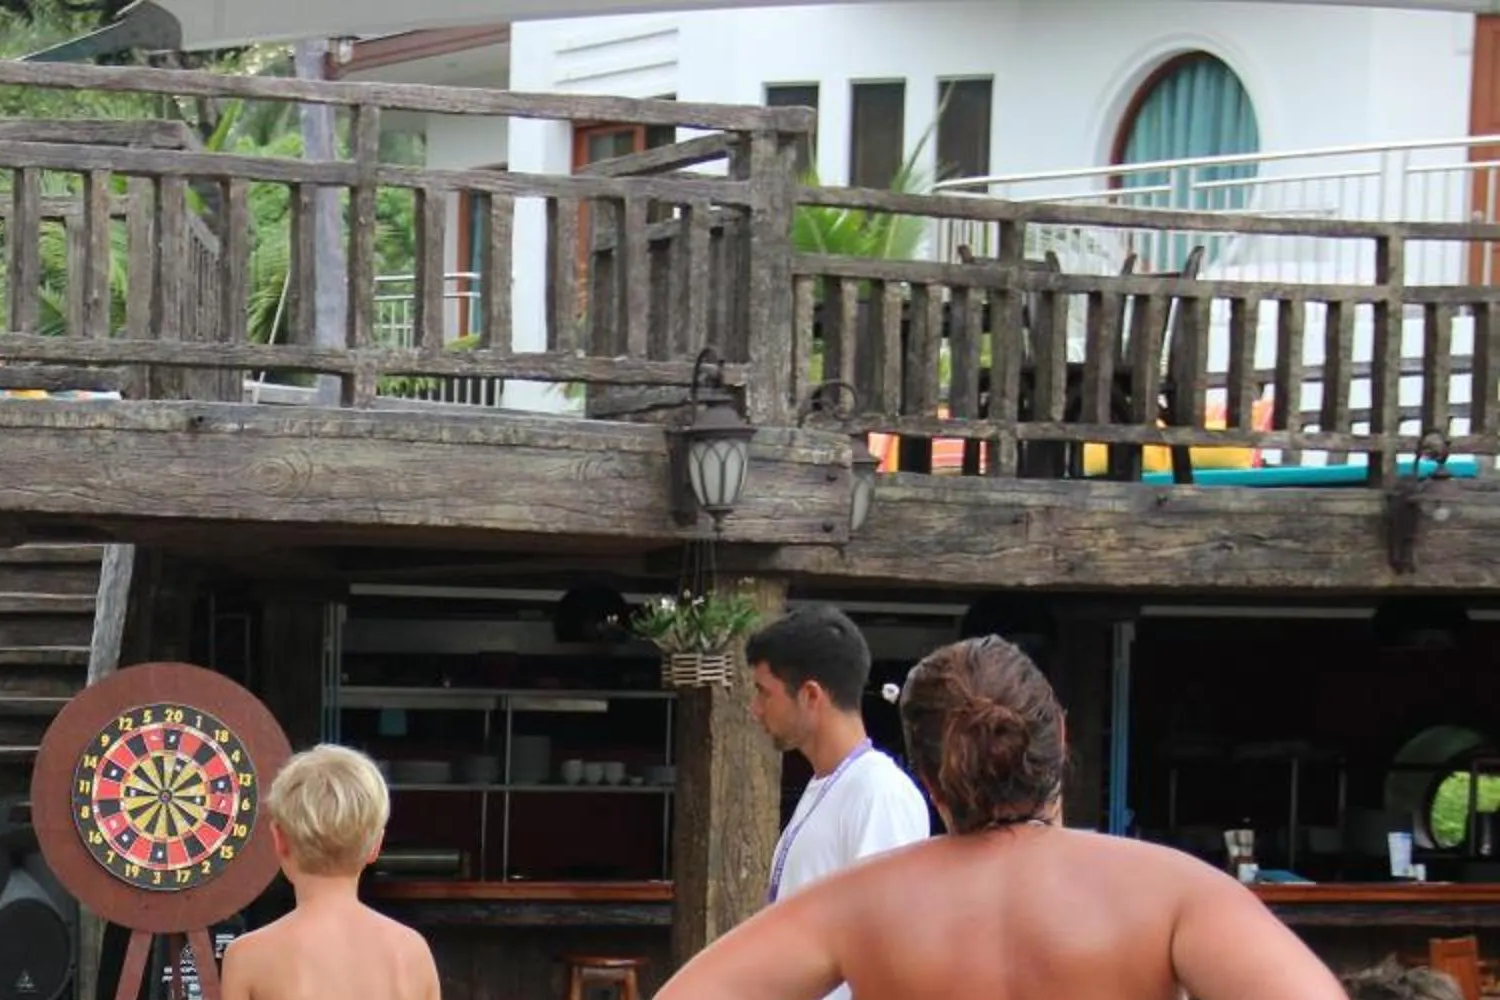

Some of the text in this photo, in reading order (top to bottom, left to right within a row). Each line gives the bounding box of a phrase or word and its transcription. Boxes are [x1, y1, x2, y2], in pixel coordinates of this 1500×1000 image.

[142, 709, 152, 723] 5
[164, 708, 184, 723] 20
[195, 714, 203, 727] 1
[119, 717, 133, 731] 12
[100, 734, 111, 747] 9
[214, 729, 229, 743] 18
[83, 754, 98, 769] 14
[231, 749, 241, 764] 4
[79, 780, 90, 793] 11
[239, 773, 252, 787] 13
[241, 797, 250, 810] 6
[81, 805, 89, 818] 8
[233, 823, 248, 837] 10
[88, 830, 102, 845] 16
[107, 851, 116, 864] 7
[220, 846, 234, 860] 15
[125, 863, 141, 878] 19
[201, 861, 211, 874] 2
[152, 871, 161, 885] 3
[176, 870, 192, 884] 17
